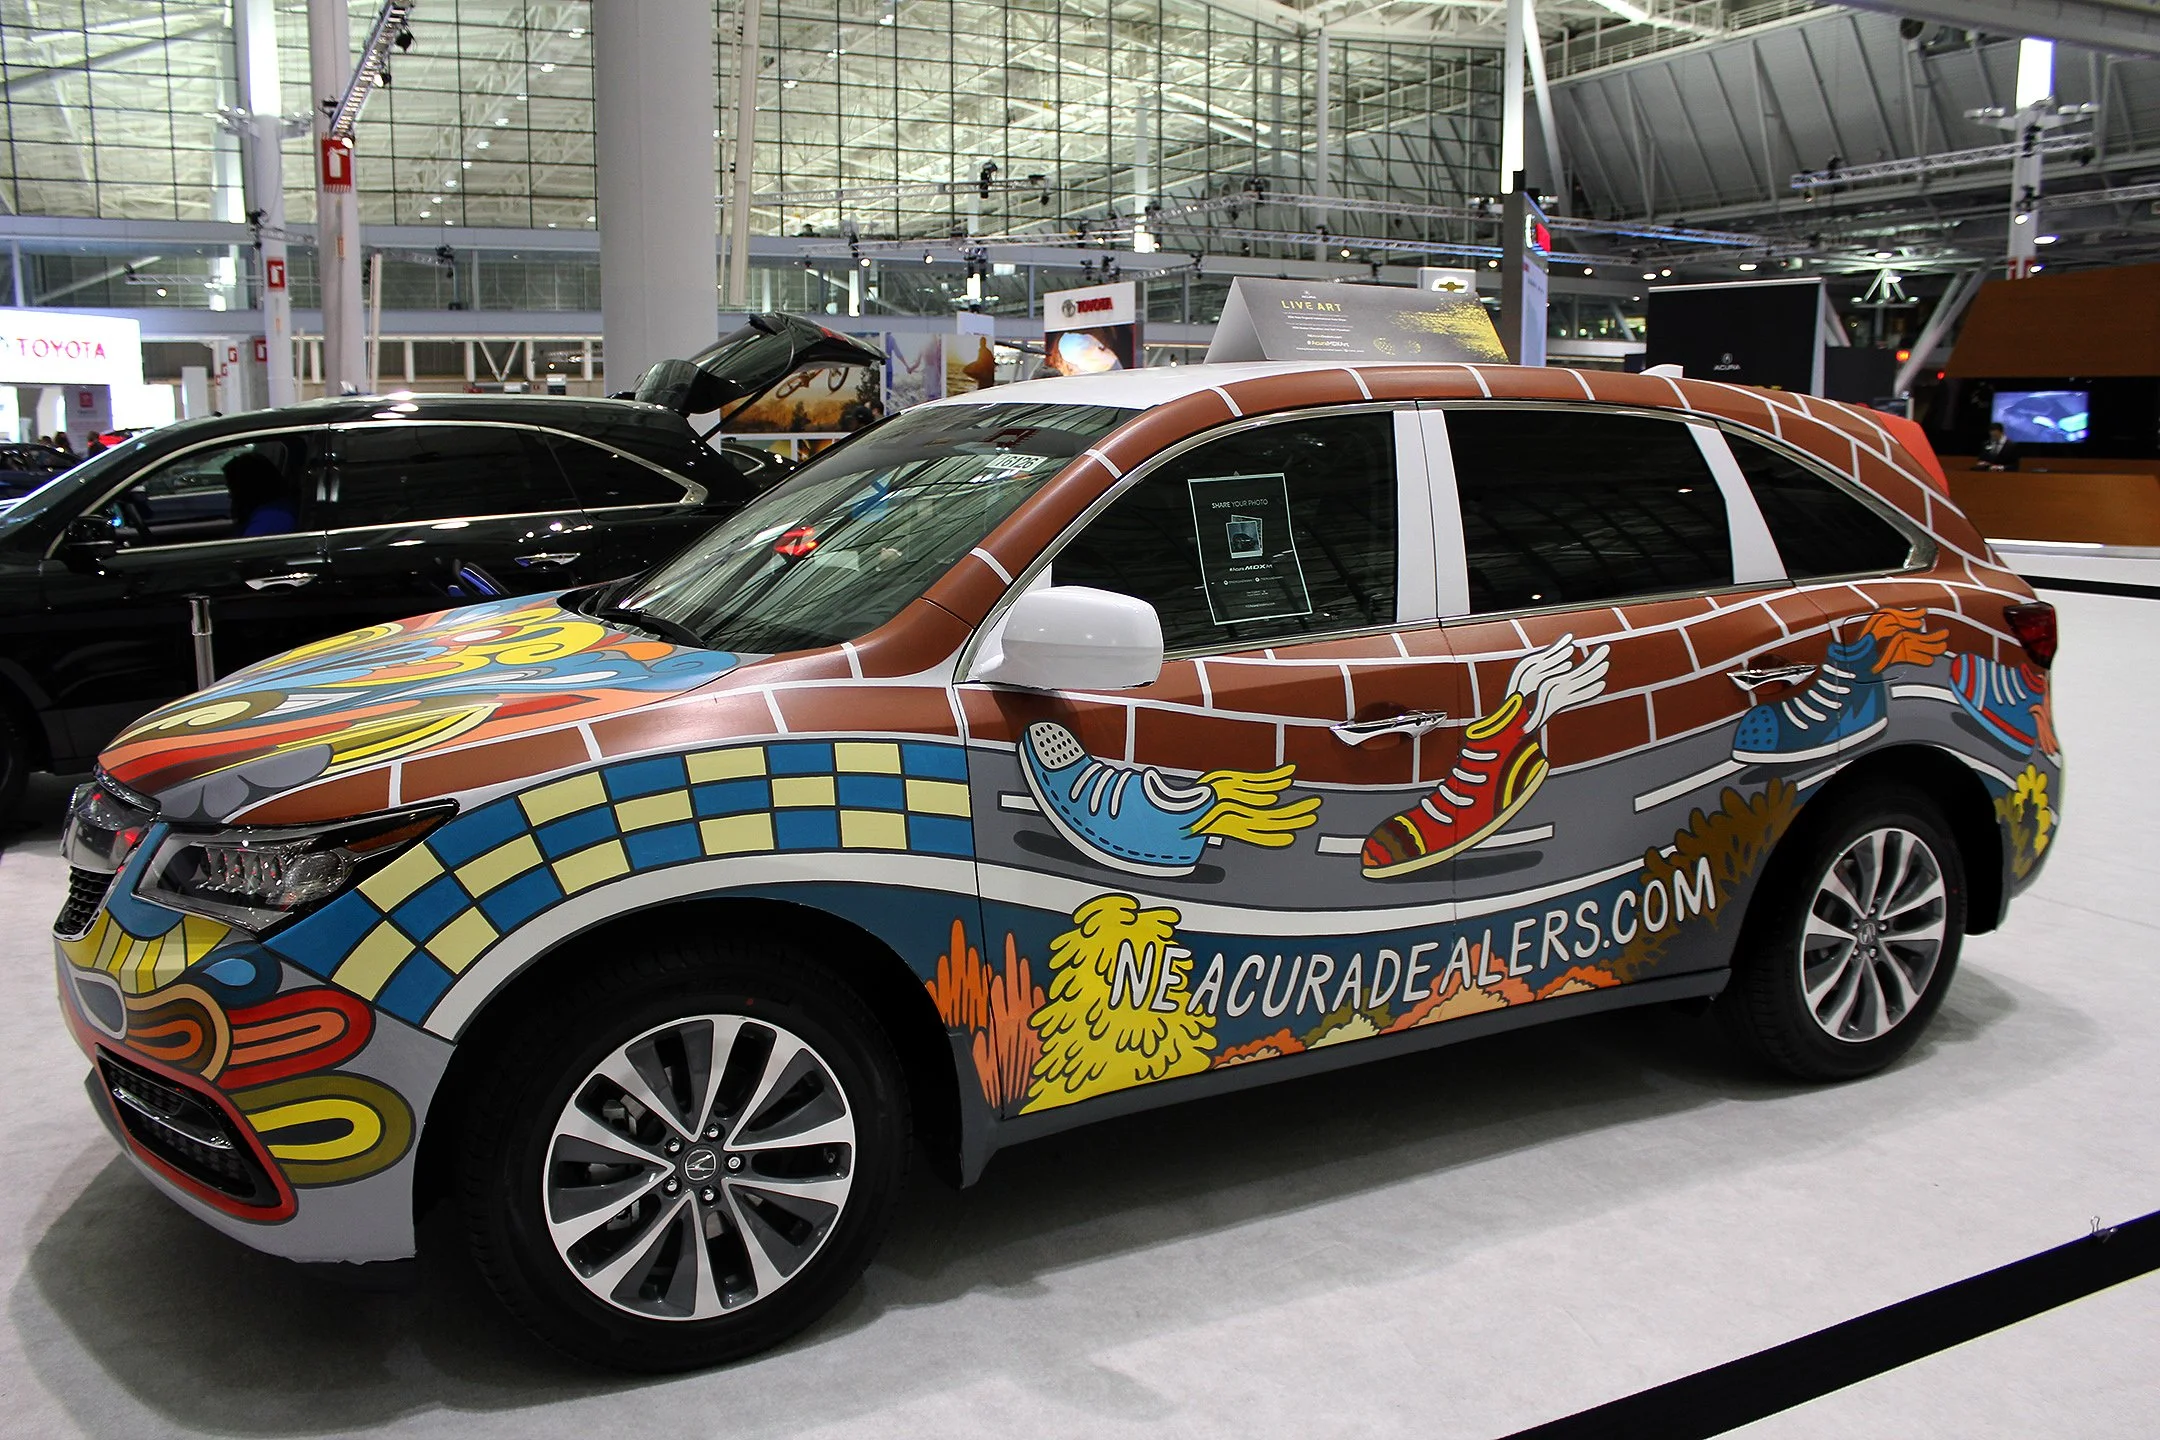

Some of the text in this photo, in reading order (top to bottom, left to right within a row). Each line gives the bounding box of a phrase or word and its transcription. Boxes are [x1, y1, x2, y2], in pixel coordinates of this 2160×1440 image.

[1076, 297, 1113, 313] TOYOTA
[1281, 300, 1342, 312] LIVE ART
[16, 338, 106, 360] TOYOTA
[1211, 498, 1269, 509] SHARE YOUR PHOTO
